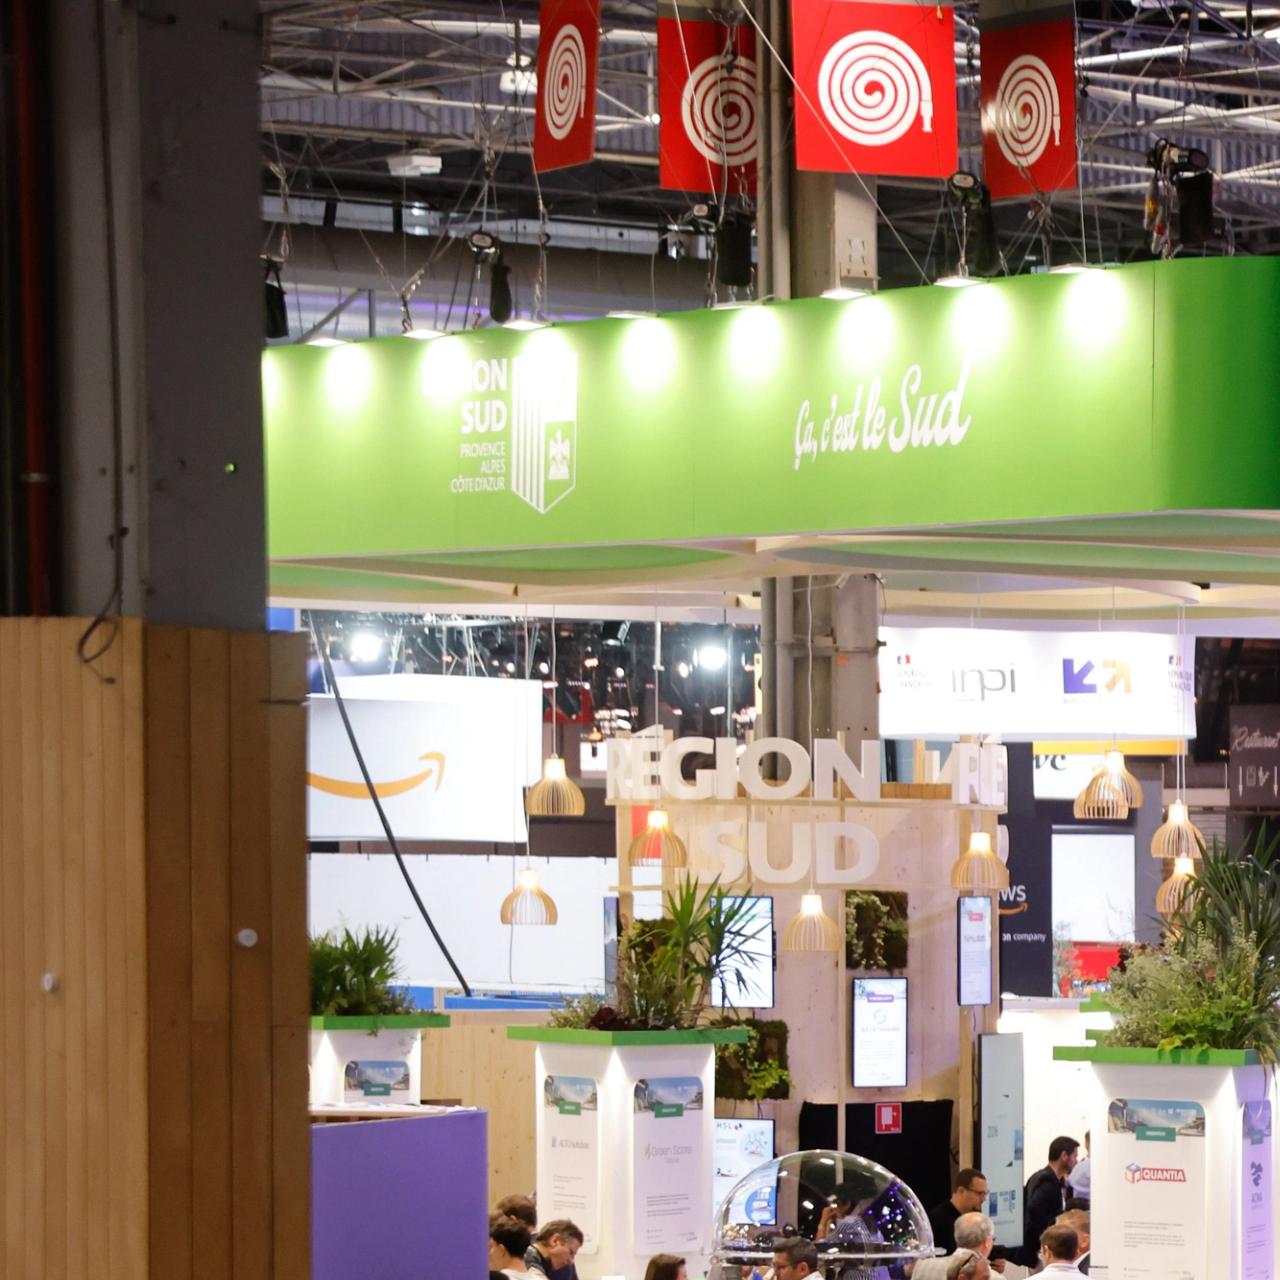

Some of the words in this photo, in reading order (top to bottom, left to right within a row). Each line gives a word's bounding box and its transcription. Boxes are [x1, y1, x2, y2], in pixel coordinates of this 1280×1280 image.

[862, 376, 886, 451] le
[888, 355, 972, 454] Sud
[460, 399, 507, 434] SUD
[460, 441, 506, 457] PROVENCE
[481, 459, 506, 474] ALPES
[700, 820, 881, 884] SUD
[1013, 932, 1047, 943] company
[1142, 1168, 1186, 1182] QUANTIA
